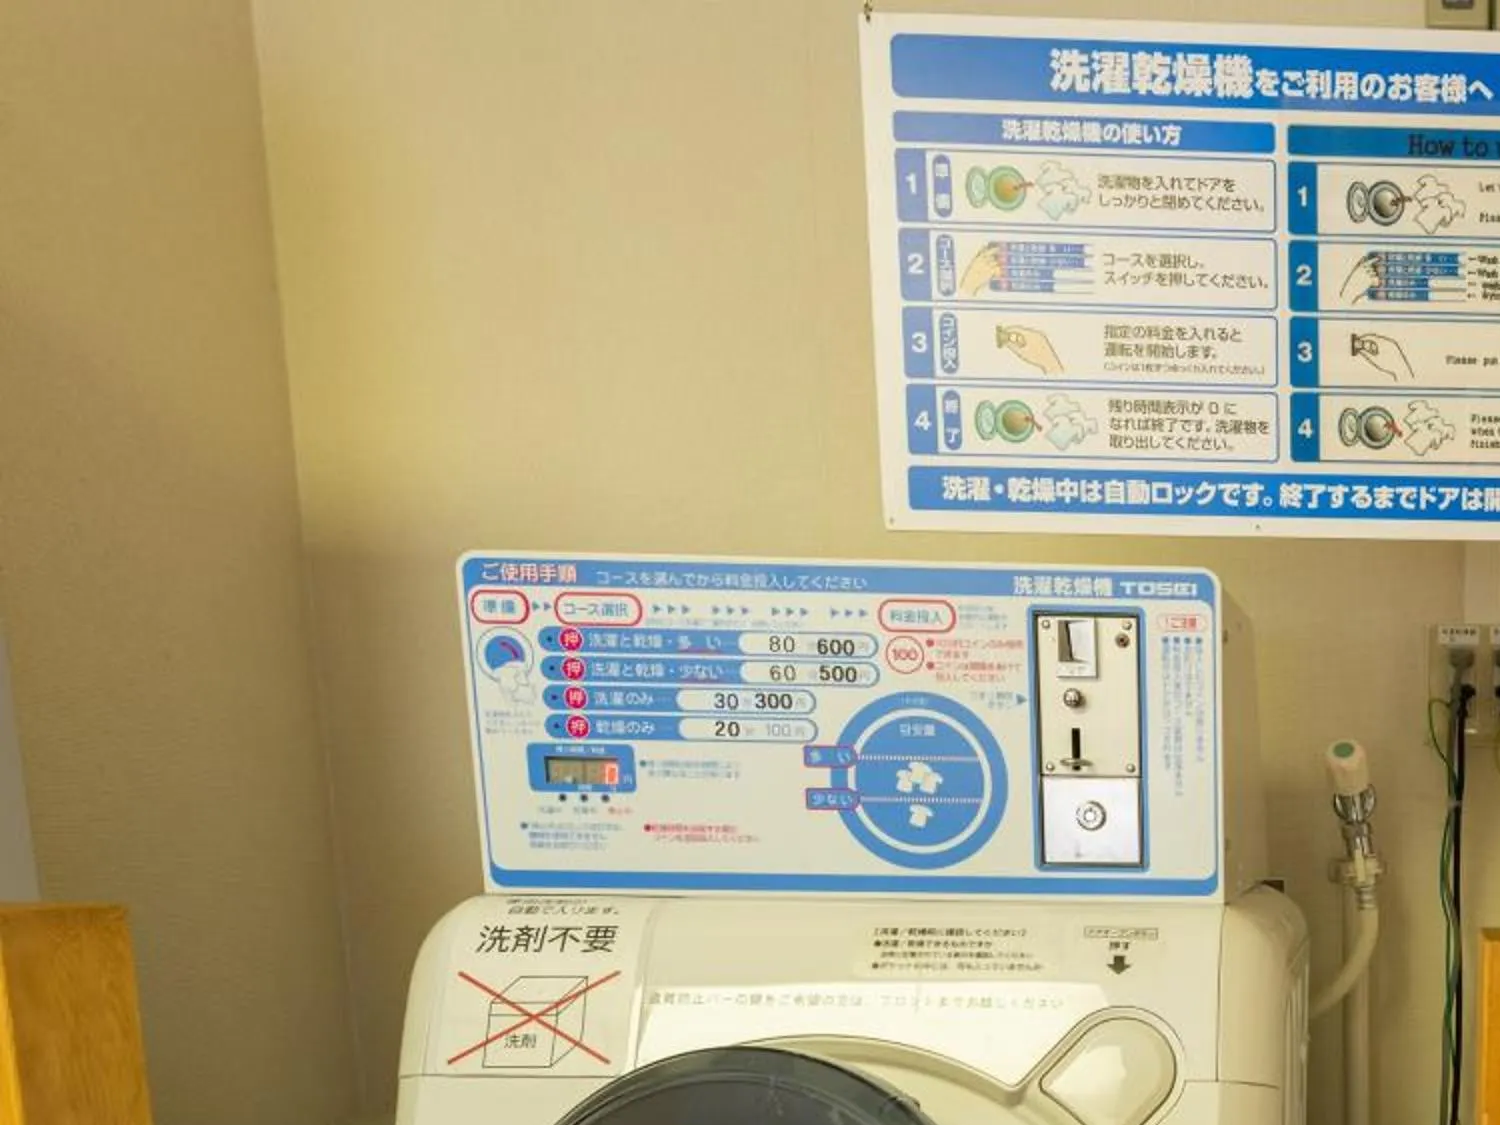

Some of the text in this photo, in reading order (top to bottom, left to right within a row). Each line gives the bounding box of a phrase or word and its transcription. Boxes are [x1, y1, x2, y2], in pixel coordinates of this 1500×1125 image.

[1048, 48, 1494, 104] 洗濯乾燥機をご利用のお客様へ
[1002, 119, 1183, 146] 洗濯乾燥機の使い方
[1408, 134, 1456, 157] How
[1462, 138, 1489, 158] to
[905, 172, 917, 194] 1
[1098, 174, 1237, 193] 洗濯物を入れてドアを
[1099, 194, 1265, 213] しっかりと閉めてください。
[1297, 187, 1309, 206] 1
[907, 254, 924, 274] 2
[1104, 271, 1269, 289] スイッチを押してください。
[1296, 265, 1313, 285] 2
[911, 333, 928, 353] 3
[1104, 325, 1243, 342] 指定の料金を入れると
[1297, 342, 1314, 363] 3
[1224, 402, 1238, 415] に
[914, 410, 932, 431] 4
[1297, 419, 1314, 439] 4
[1109, 435, 1234, 451] 取り出してください。
[481, 563, 577, 583] ご使用手順
[769, 635, 796, 652] 80
[816, 638, 855, 656] 600
[891, 647, 918, 662] 100
[770, 664, 796, 681] 60
[818, 664, 857, 683] 500
[713, 693, 739, 710] 30
[754, 693, 793, 710] 300
[714, 720, 741, 737] 20
[604, 761, 620, 785] 0
[475, 924, 619, 953] 洗剤不要
[503, 1033, 537, 1050] 洗剤
